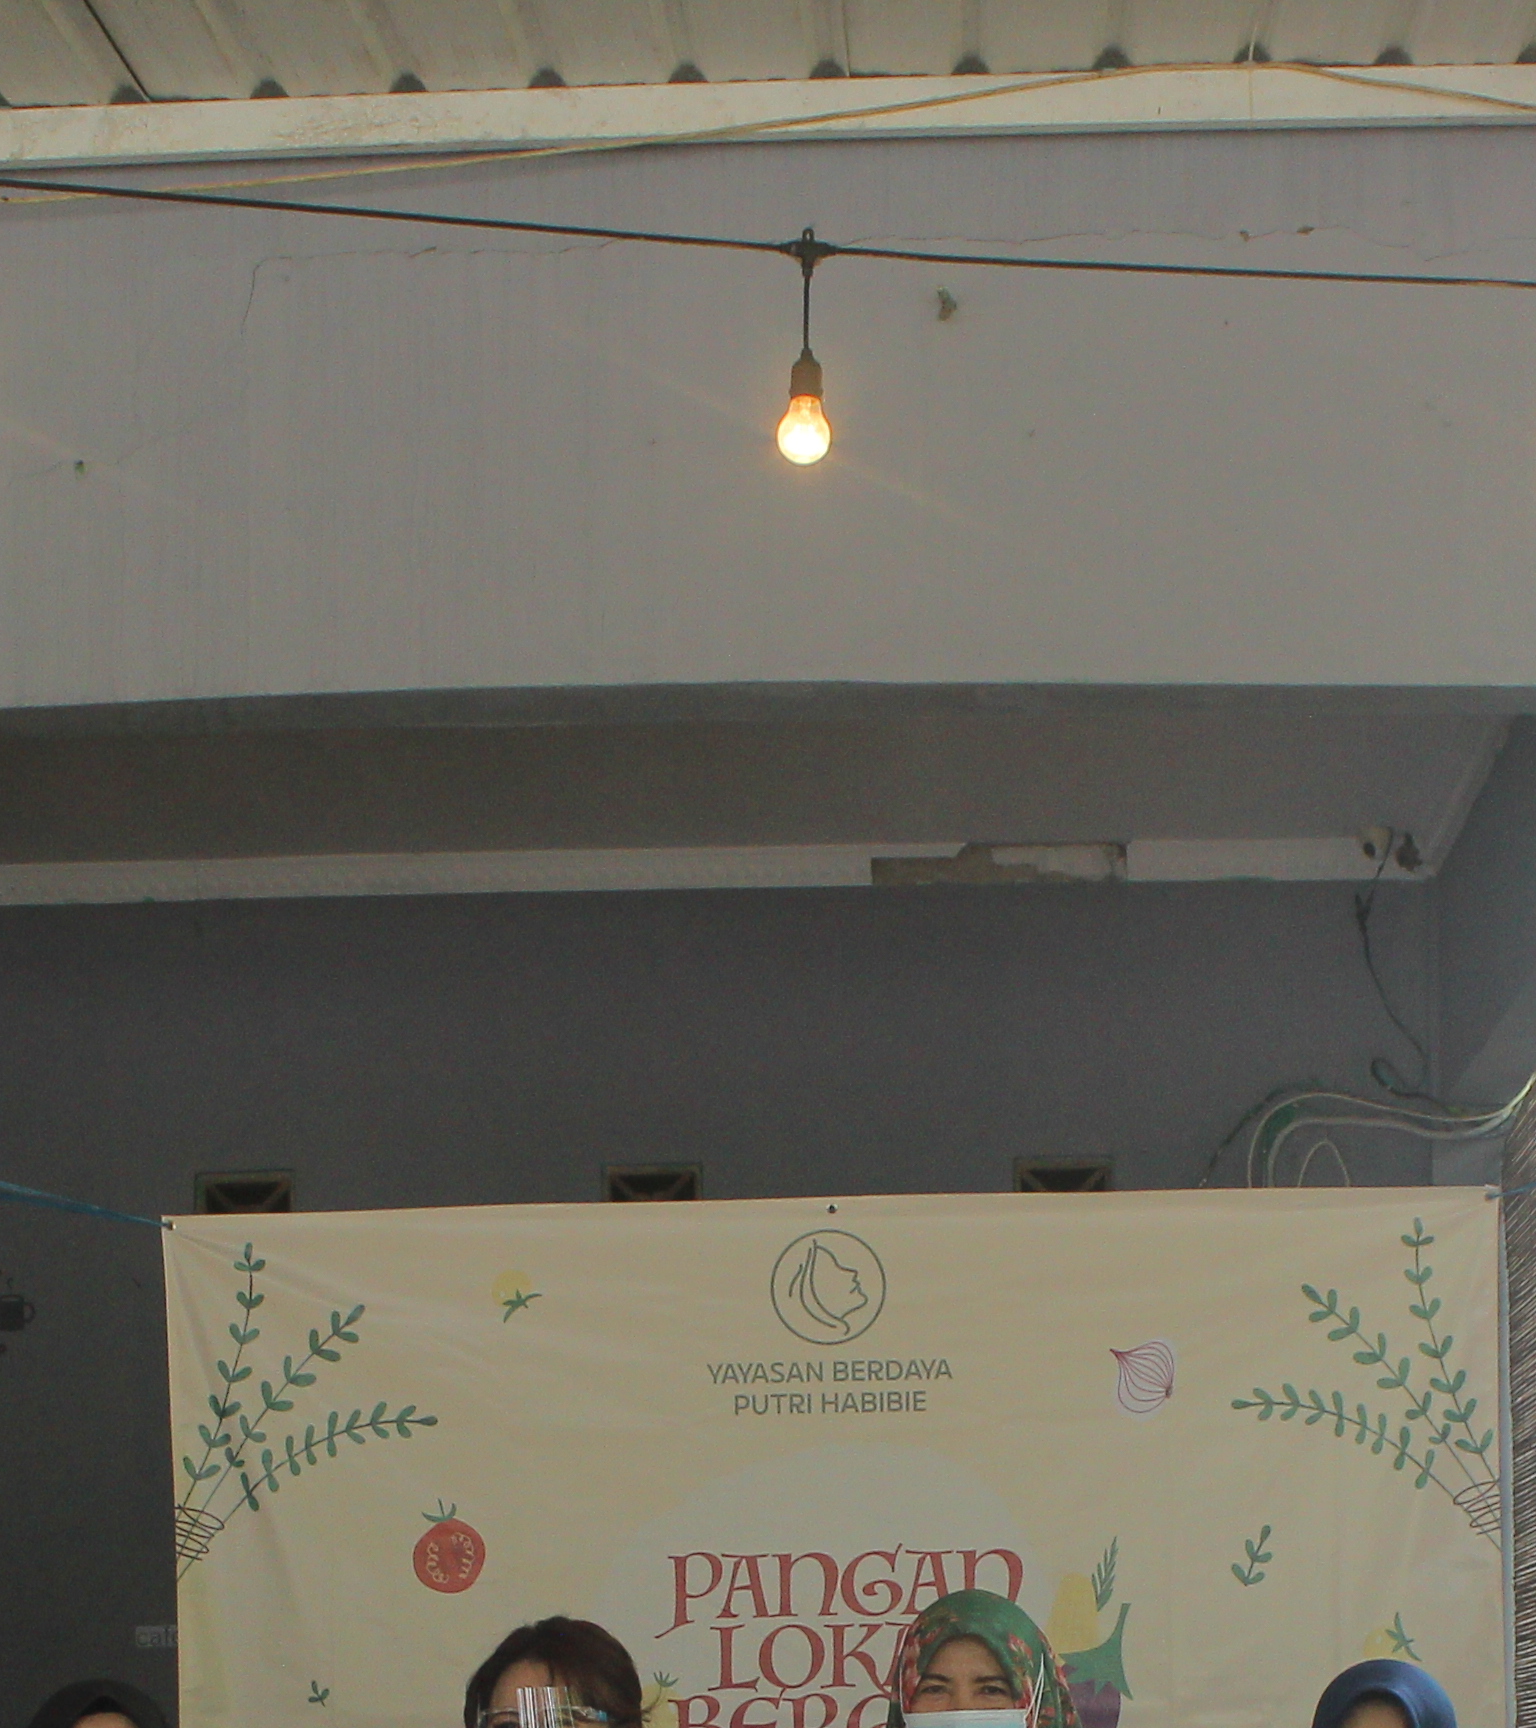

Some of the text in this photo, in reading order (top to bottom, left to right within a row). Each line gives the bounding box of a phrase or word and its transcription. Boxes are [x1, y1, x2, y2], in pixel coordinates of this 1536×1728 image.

[707, 1359, 953, 1384] YAYASAN BERDAYA
[734, 1391, 926, 1415] PUTRI HABIBIE
